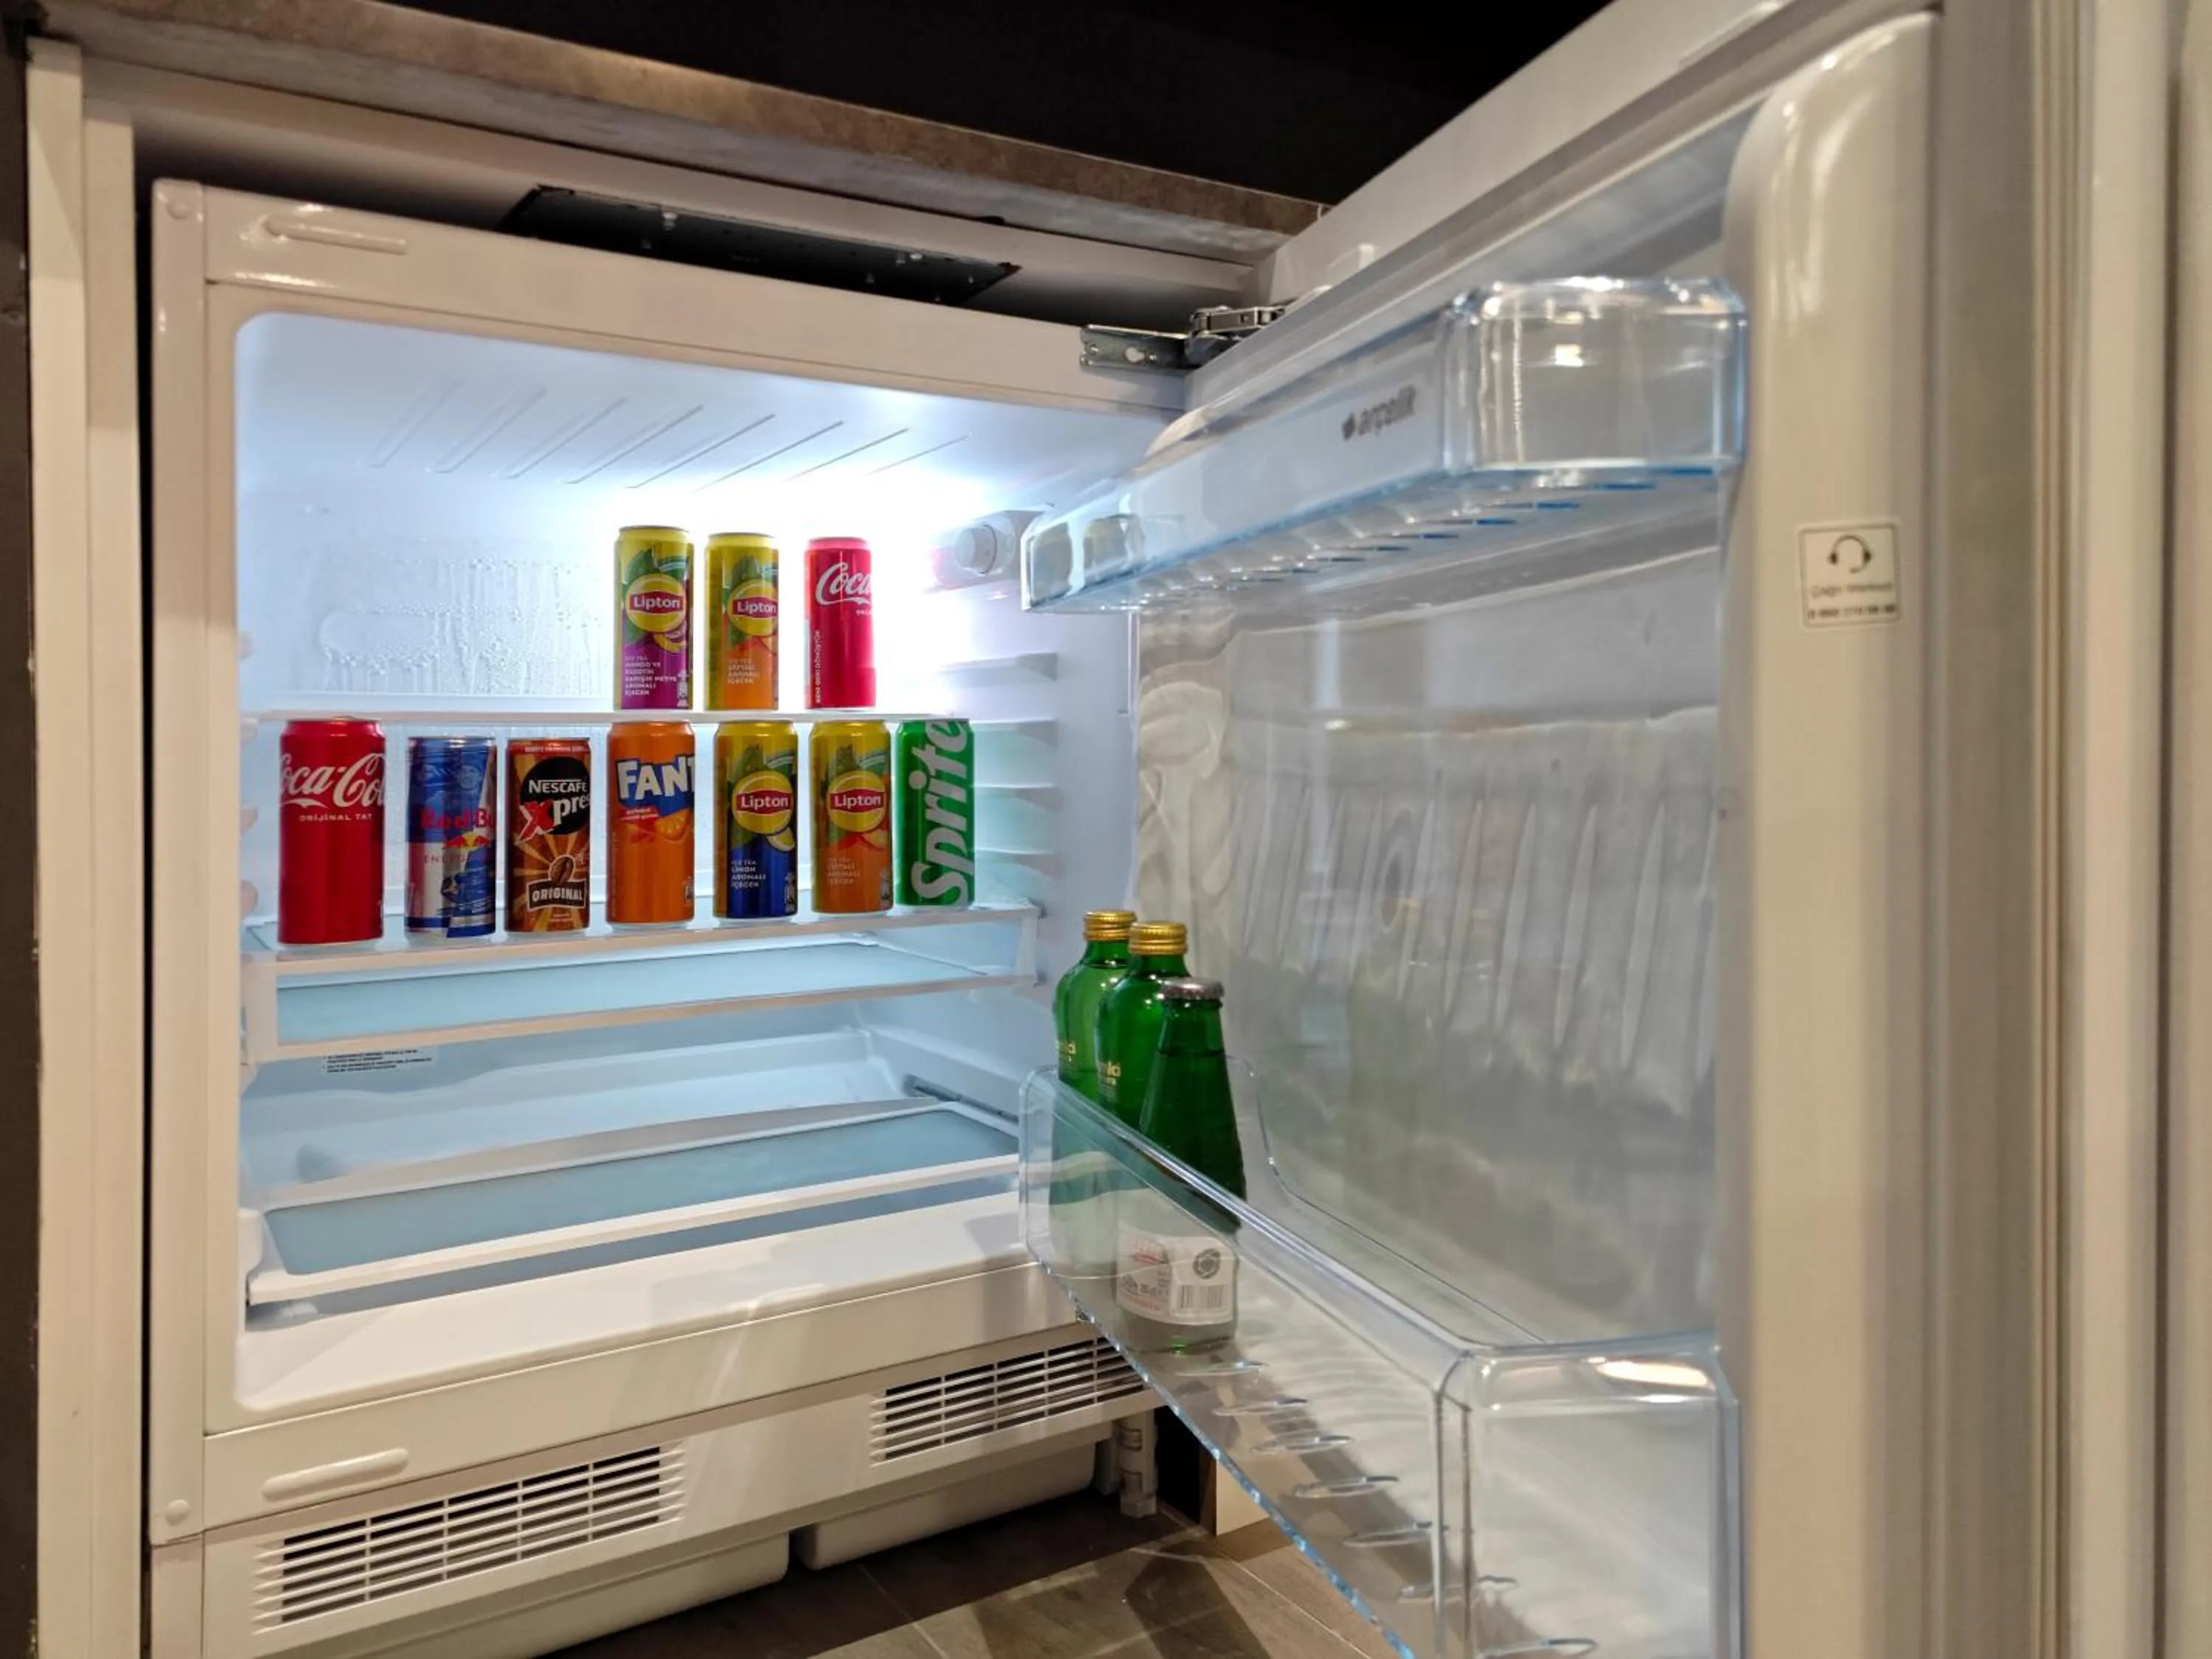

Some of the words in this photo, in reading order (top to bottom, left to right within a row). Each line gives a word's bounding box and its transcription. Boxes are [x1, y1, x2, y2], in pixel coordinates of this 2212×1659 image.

[633, 595, 681, 610] Lipton
[737, 601, 776, 615] Lipton
[740, 793, 788, 810] Lipton
[834, 793, 882, 809] Lipton
[908, 720, 975, 906] Sprite
[532, 887, 584, 902] ORIGINAL
